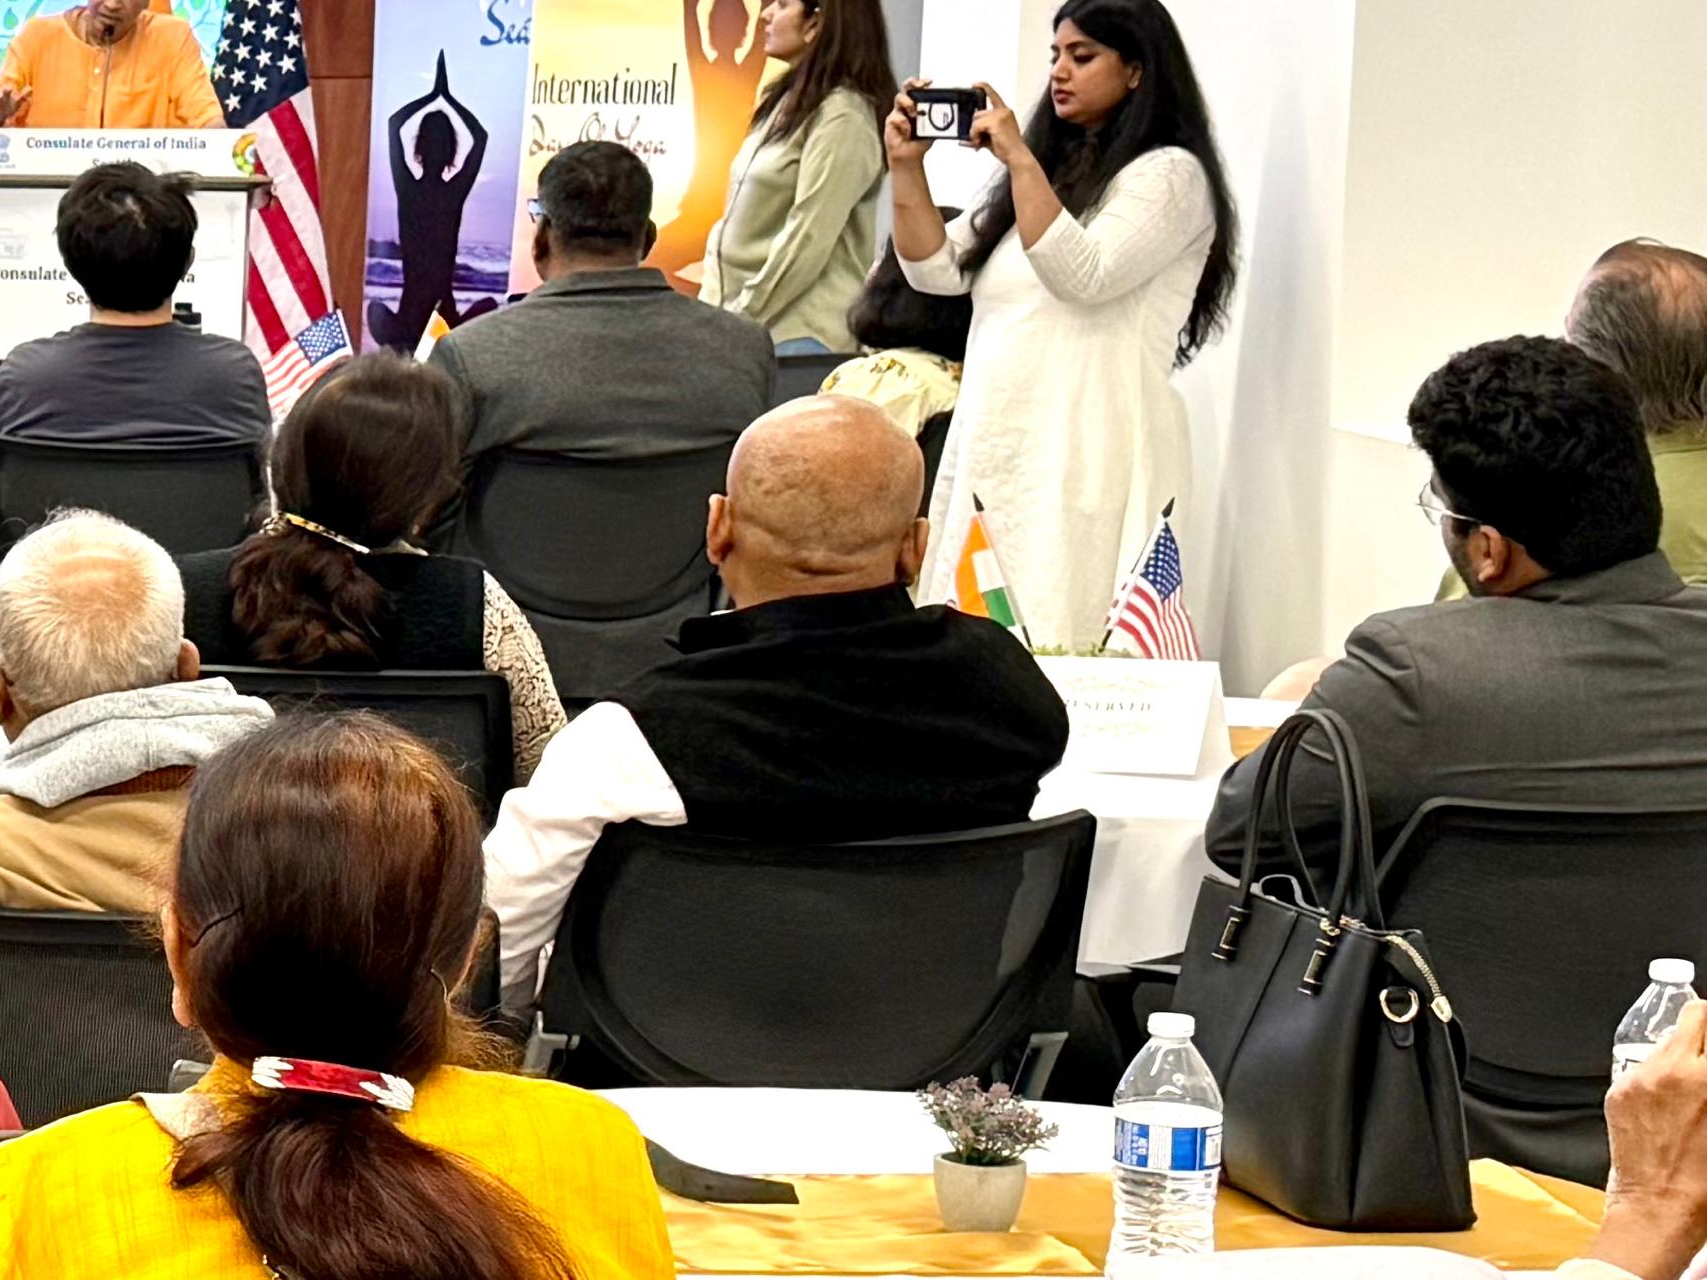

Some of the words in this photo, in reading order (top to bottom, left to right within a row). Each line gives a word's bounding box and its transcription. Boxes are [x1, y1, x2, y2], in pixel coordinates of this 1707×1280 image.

[532, 62, 677, 105] International
[26, 136, 93, 149] Consulate
[97, 136, 150, 149] General
[154, 136, 168, 149] of
[171, 136, 207, 150] India
